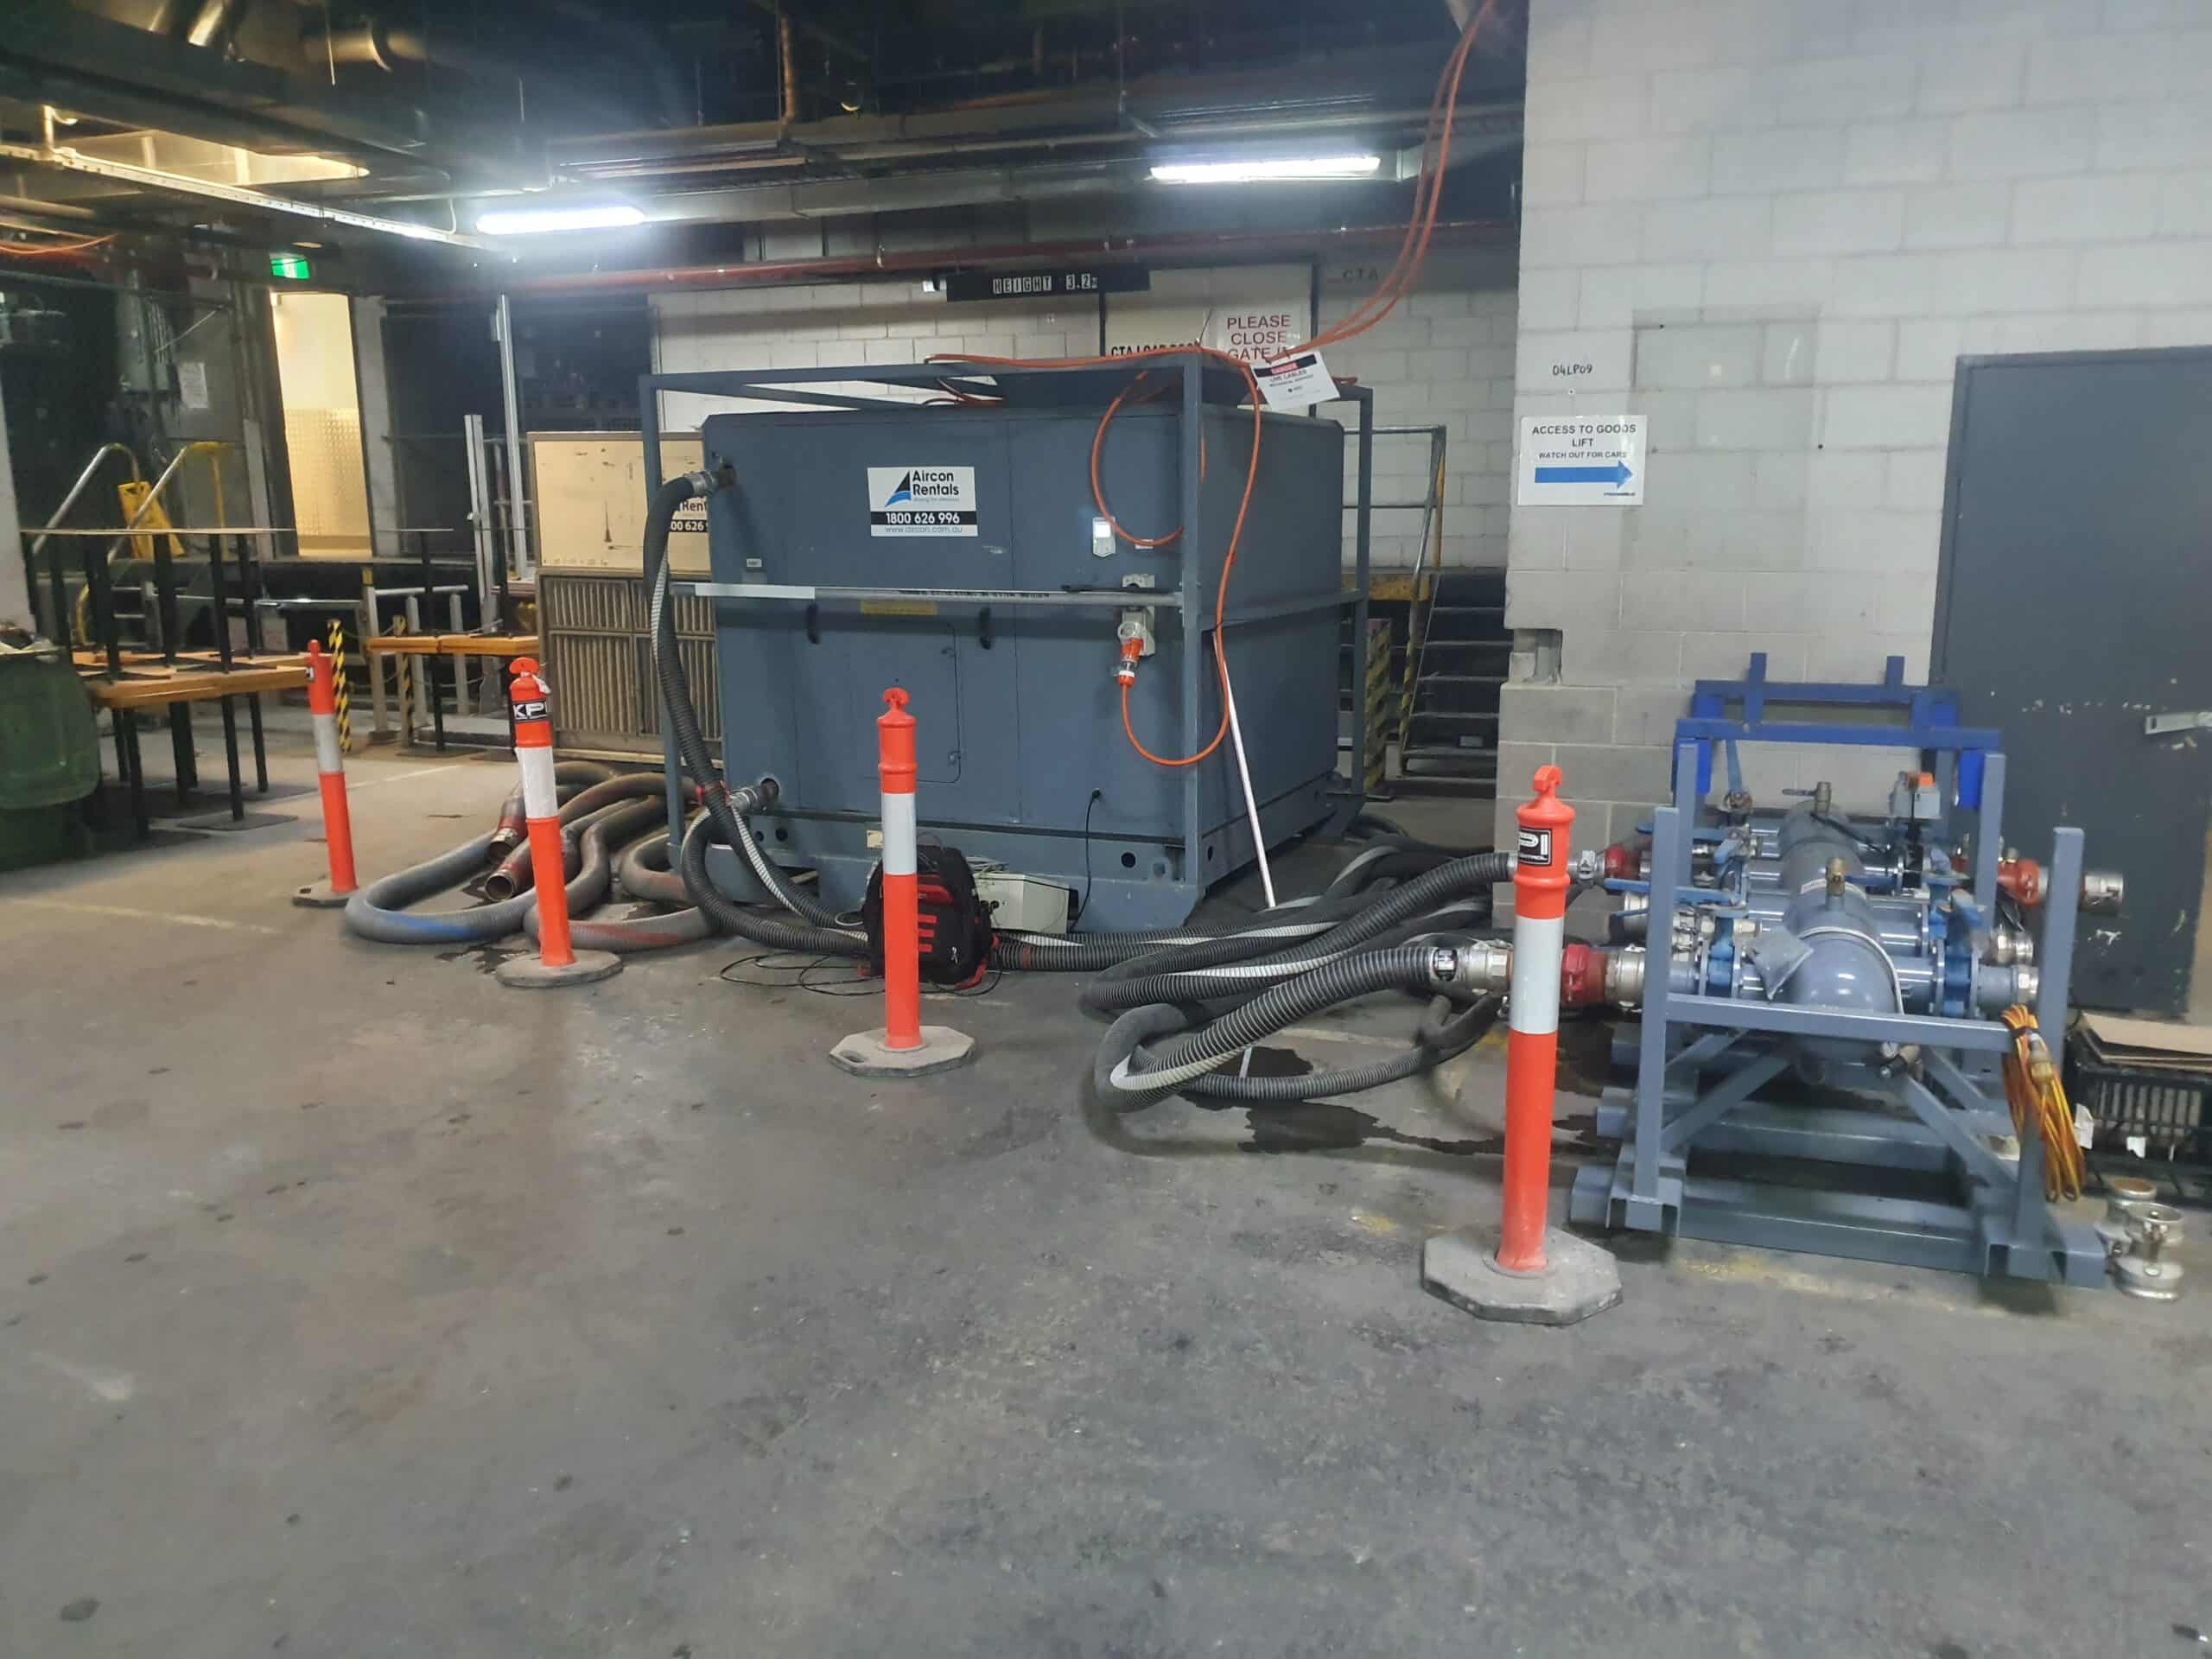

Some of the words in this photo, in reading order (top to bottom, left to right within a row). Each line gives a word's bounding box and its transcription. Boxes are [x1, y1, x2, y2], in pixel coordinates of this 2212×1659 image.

[993, 276, 1052, 294] HEIGHT
[1227, 315, 1292, 329] PLEASE
[1230, 331, 1287, 346] CLOSE
[1228, 347, 1271, 360] GATE
[1532, 424, 1575, 435] ACCESS
[1580, 424, 1593, 434] TO
[1596, 424, 1636, 434] GOODS
[1572, 438, 1593, 448] LIFT
[1538, 451, 1567, 460] WATCH
[912, 470, 954, 482] Aircon
[912, 484, 959, 495] Rentals
[886, 512, 911, 524] 1800
[914, 512, 935, 524] 626
[938, 512, 960, 524] 996
[684, 520, 704, 531] 626
[512, 702, 546, 717] KP
